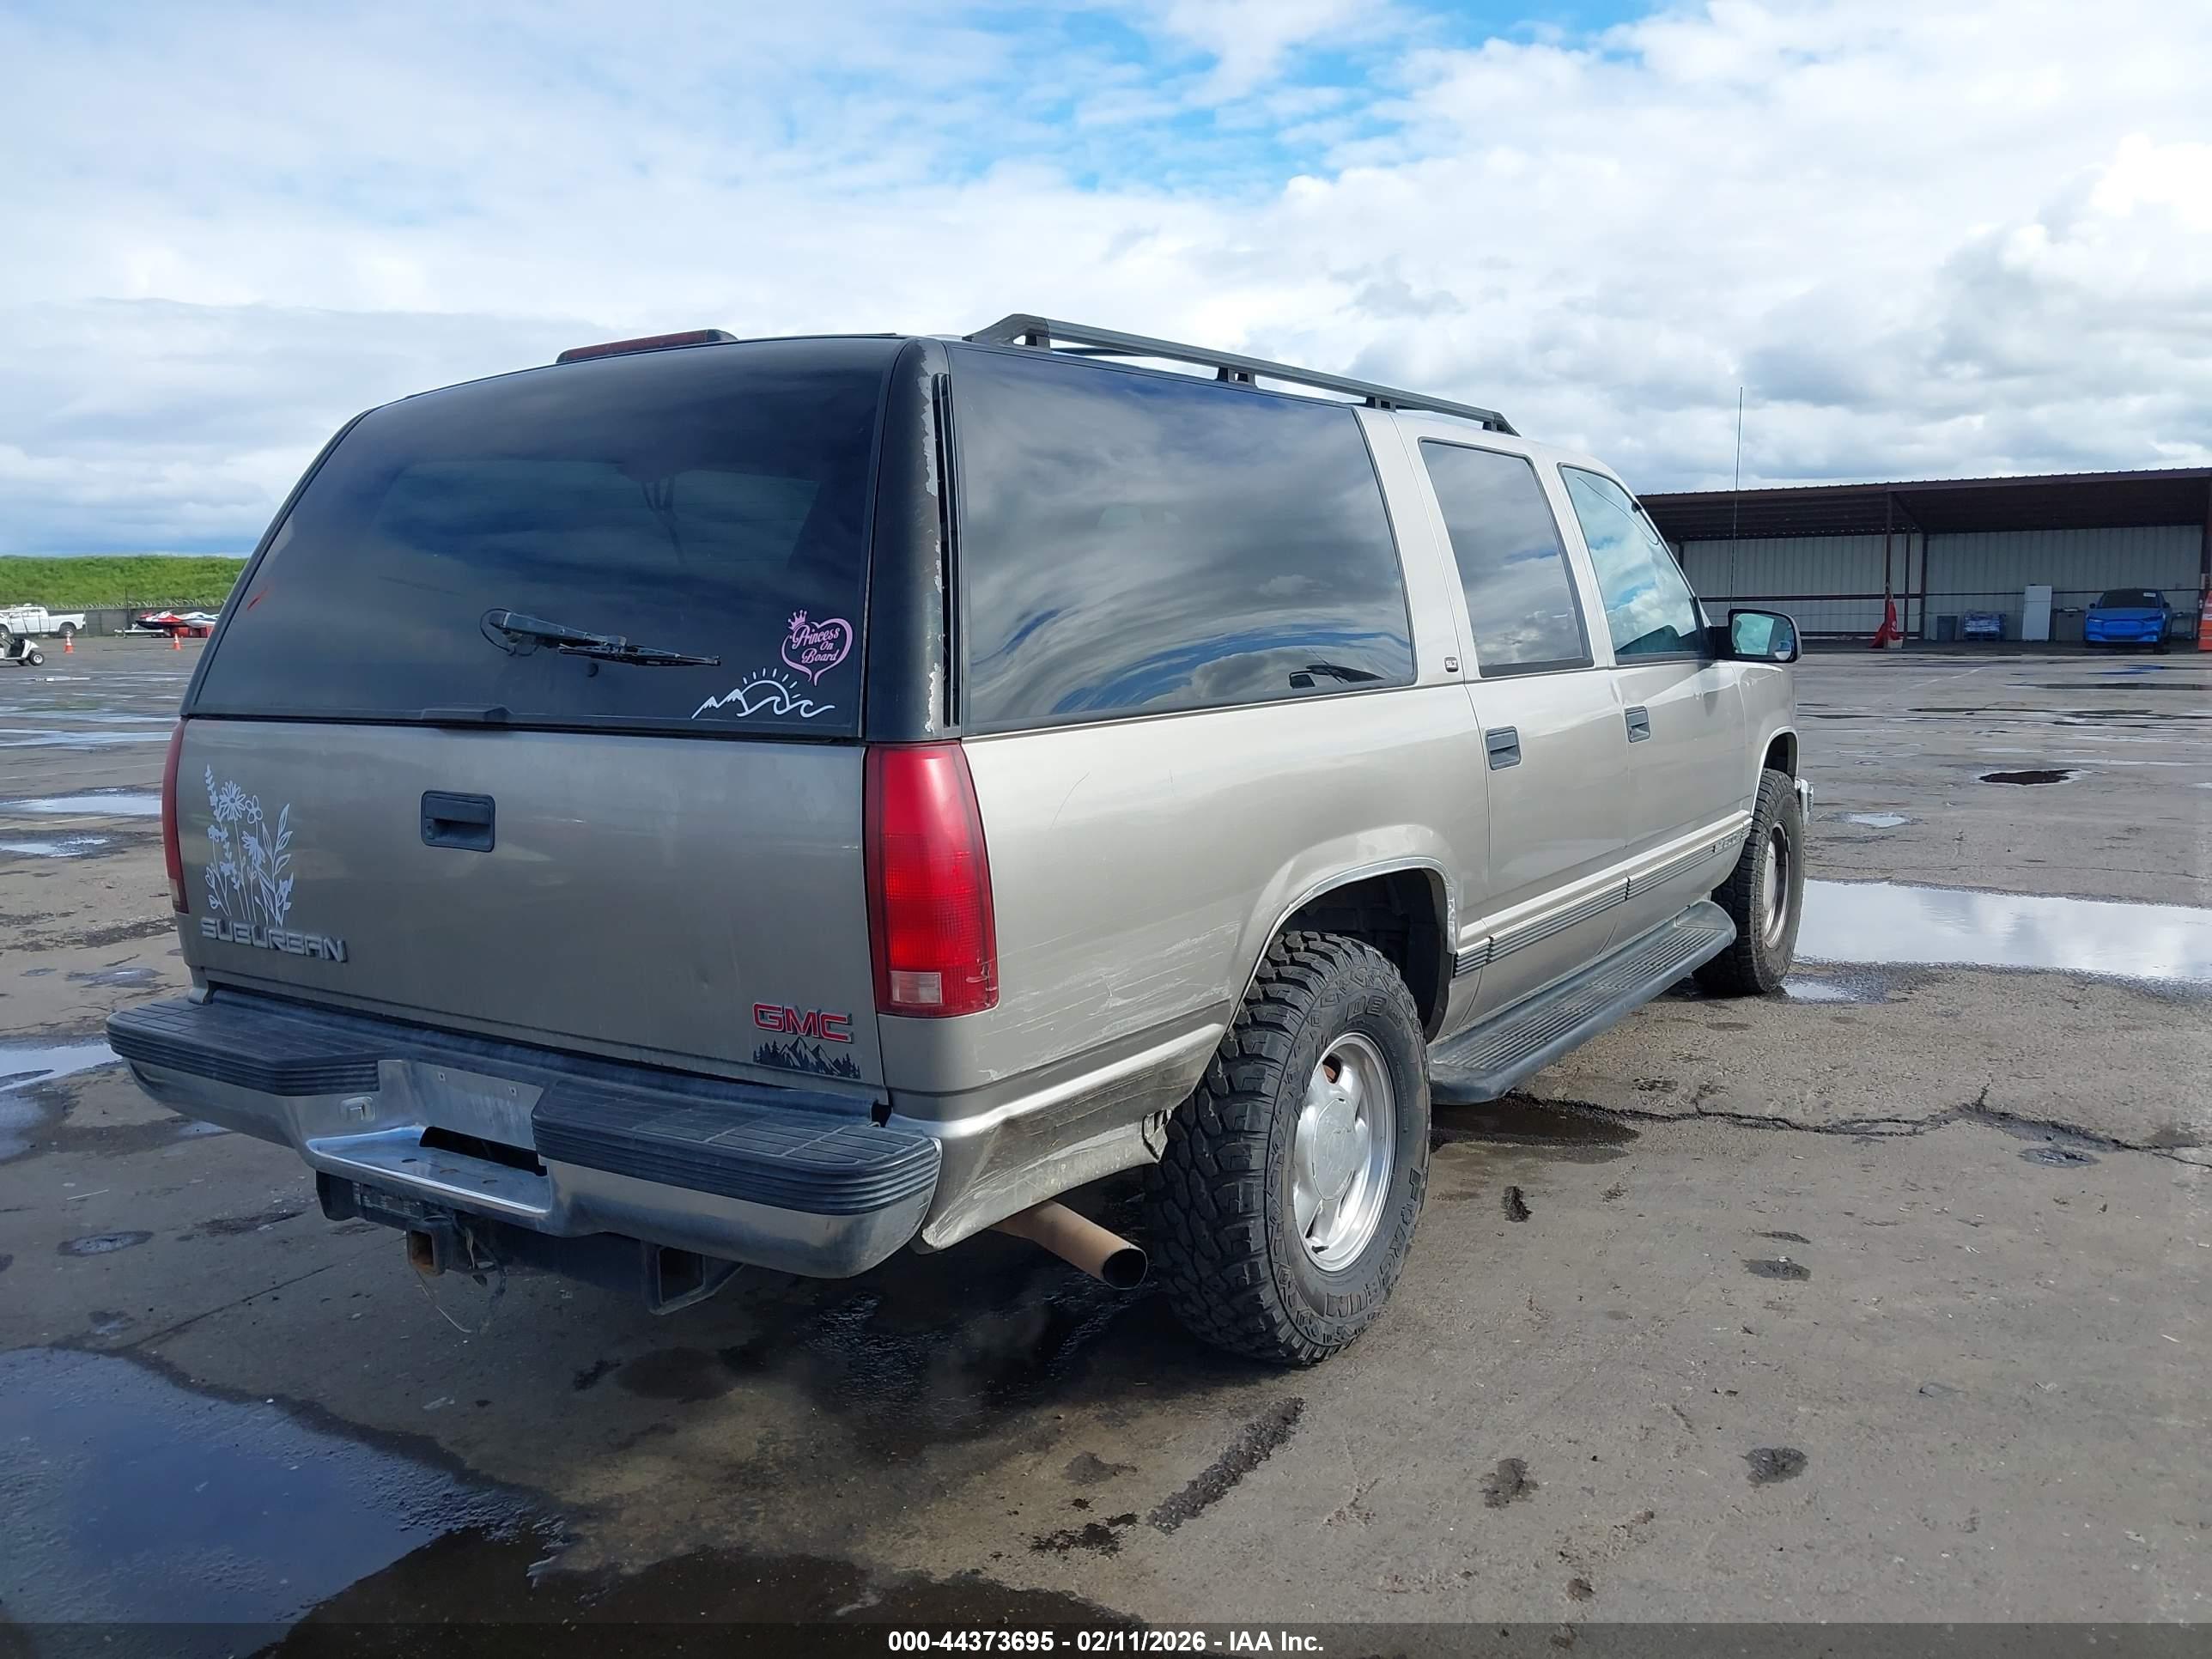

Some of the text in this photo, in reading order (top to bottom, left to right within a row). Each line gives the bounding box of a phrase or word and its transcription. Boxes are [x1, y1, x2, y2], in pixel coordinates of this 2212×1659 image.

[792, 625, 841, 649] Princess
[820, 641, 834, 650] On
[802, 648, 839, 664] Board
[201, 916, 348, 962] SUBURBAN
[753, 1003, 853, 1043] GMC
